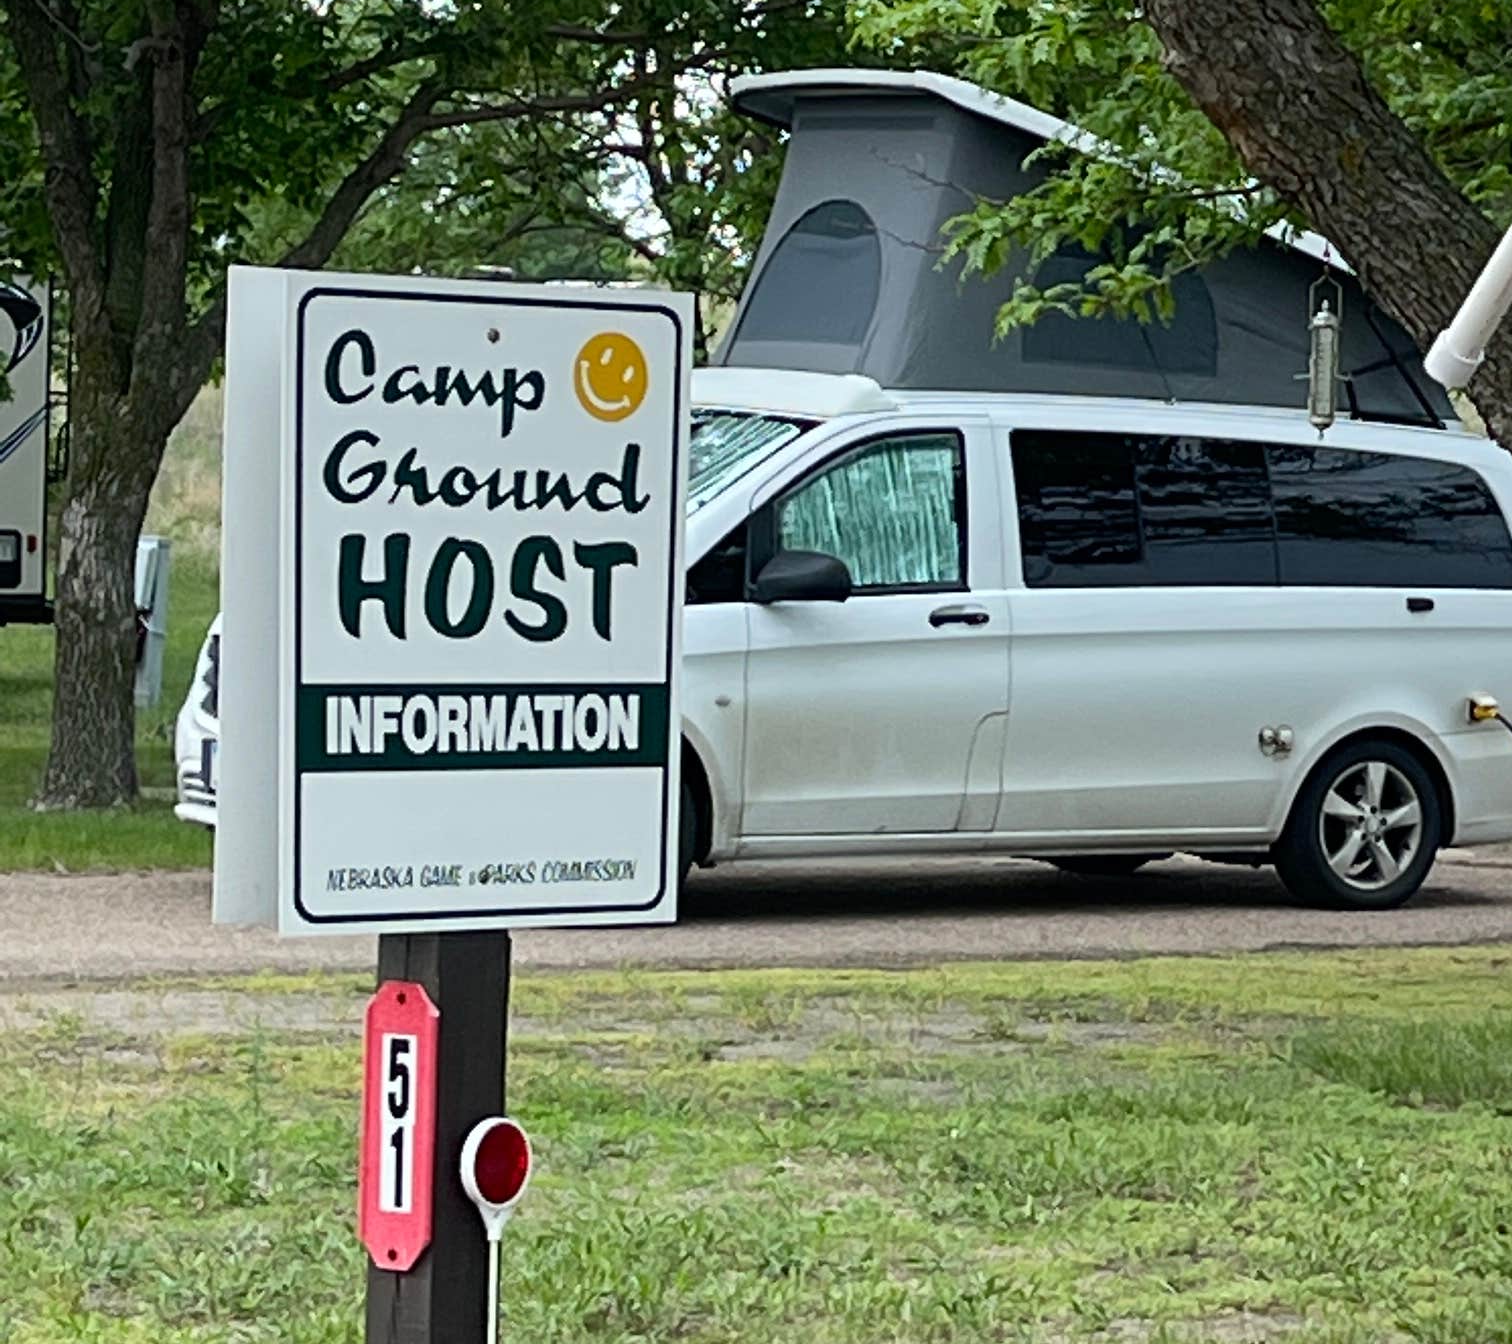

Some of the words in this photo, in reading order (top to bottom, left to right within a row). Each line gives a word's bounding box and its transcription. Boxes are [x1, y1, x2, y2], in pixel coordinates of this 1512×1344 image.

[324, 329, 546, 438] Camp
[323, 429, 651, 514] Ground
[338, 532, 639, 643] HOST
[325, 693, 640, 755] INFORMATION
[327, 866, 414, 892] NEBRASKA
[420, 864, 463, 888] GAME
[387, 1038, 411, 1209] 51
